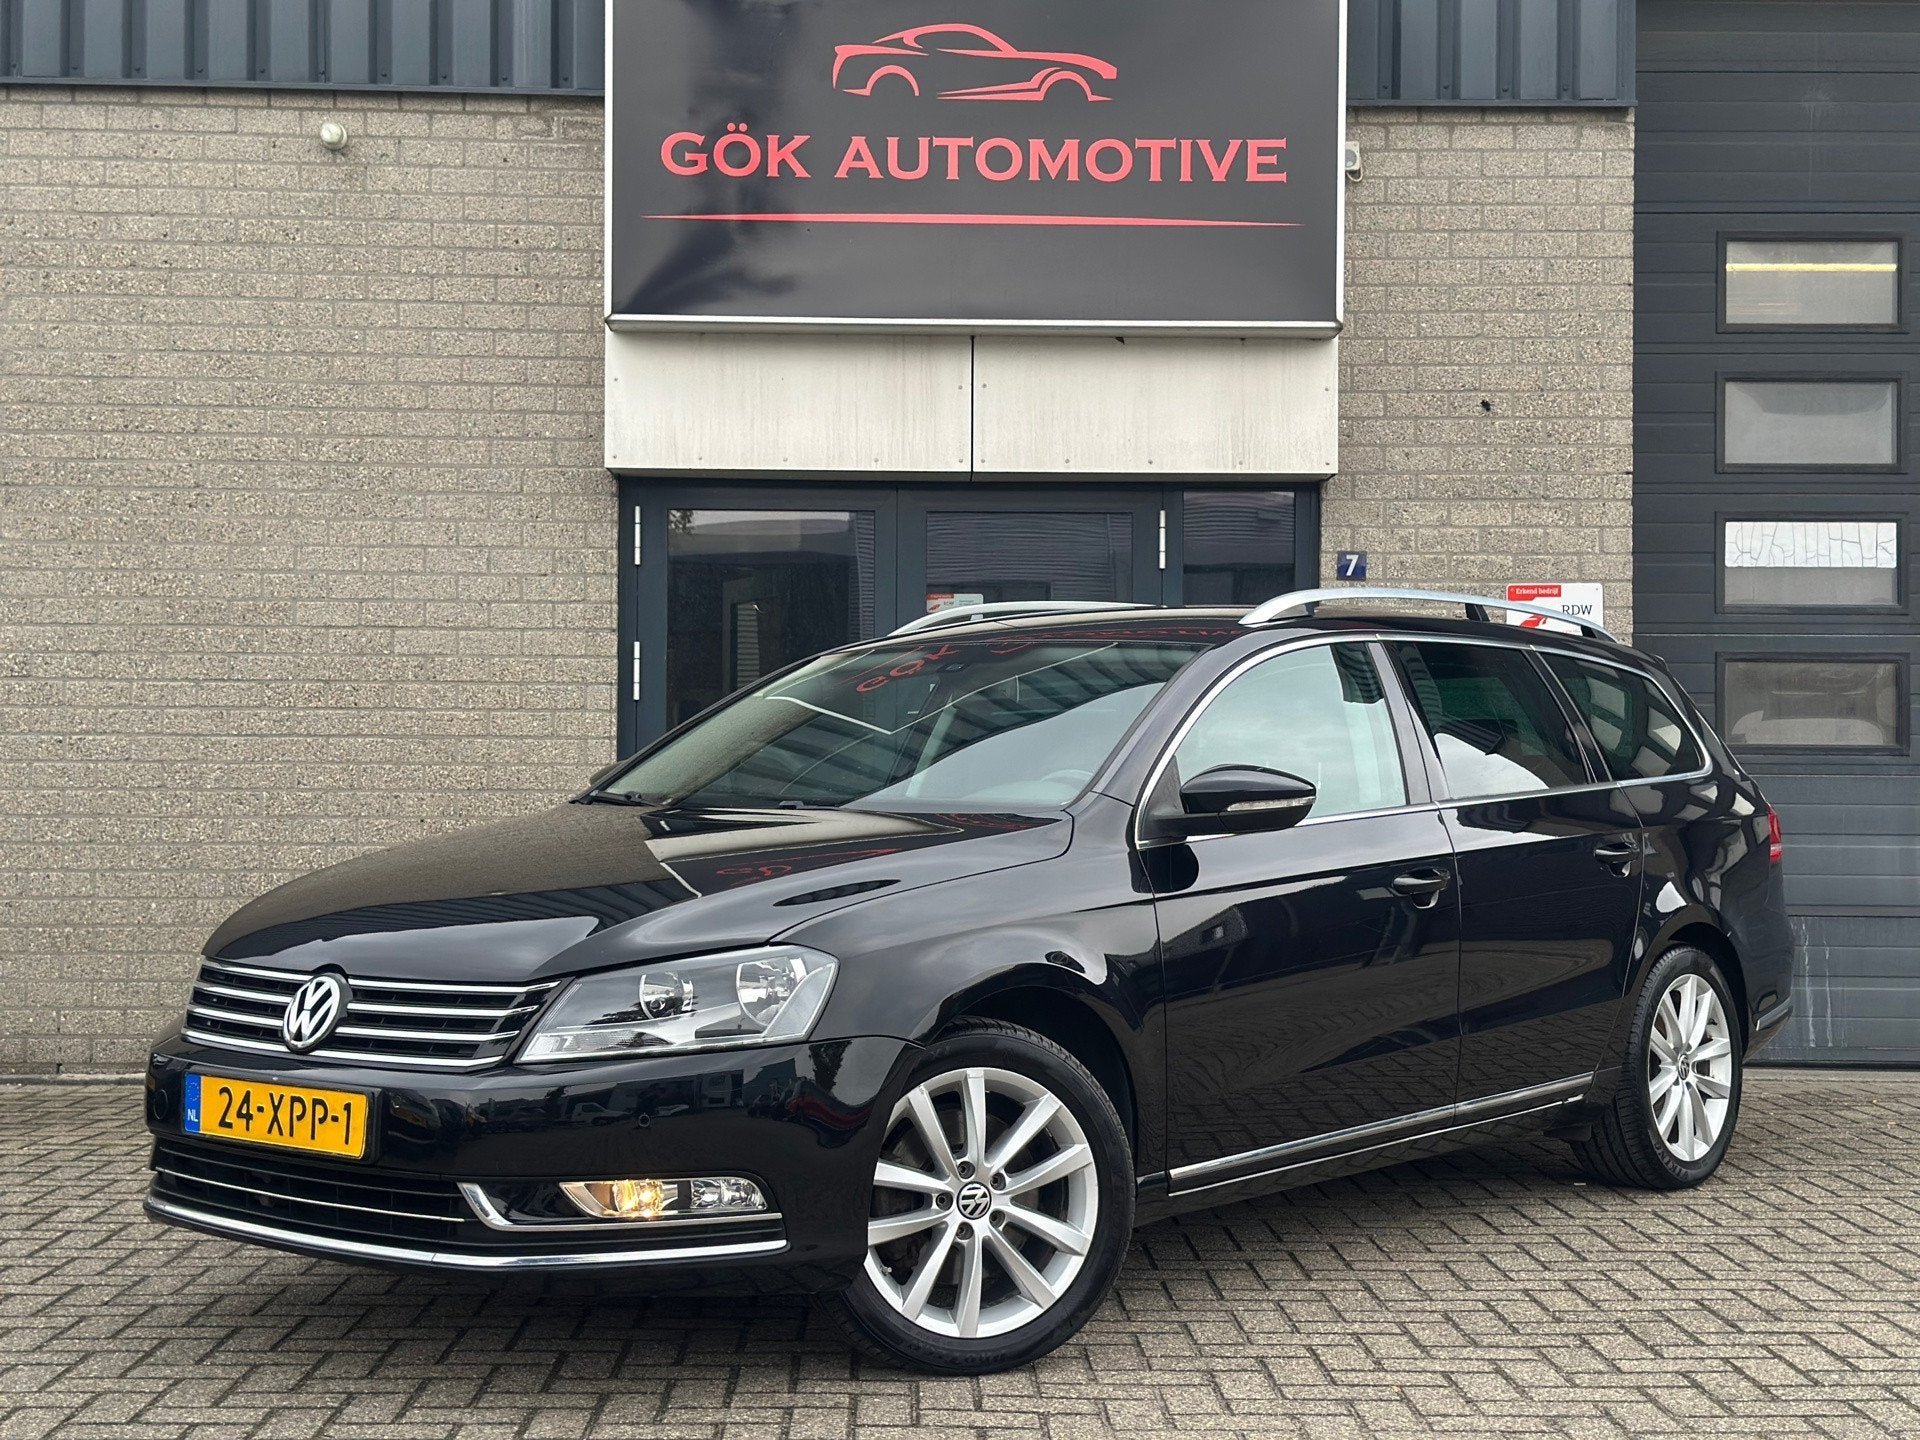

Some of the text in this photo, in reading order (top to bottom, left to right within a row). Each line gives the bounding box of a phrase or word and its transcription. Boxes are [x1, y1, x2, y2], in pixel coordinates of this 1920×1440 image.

[660, 122, 1289, 184] GÖK AUTOMOTIVE
[1345, 554, 1359, 576] 7
[1515, 587, 1538, 595] Erkend
[1561, 604, 1593, 616] RDW
[187, 1108, 199, 1122] NL
[218, 1085, 353, 1146] 24-XPP-1
